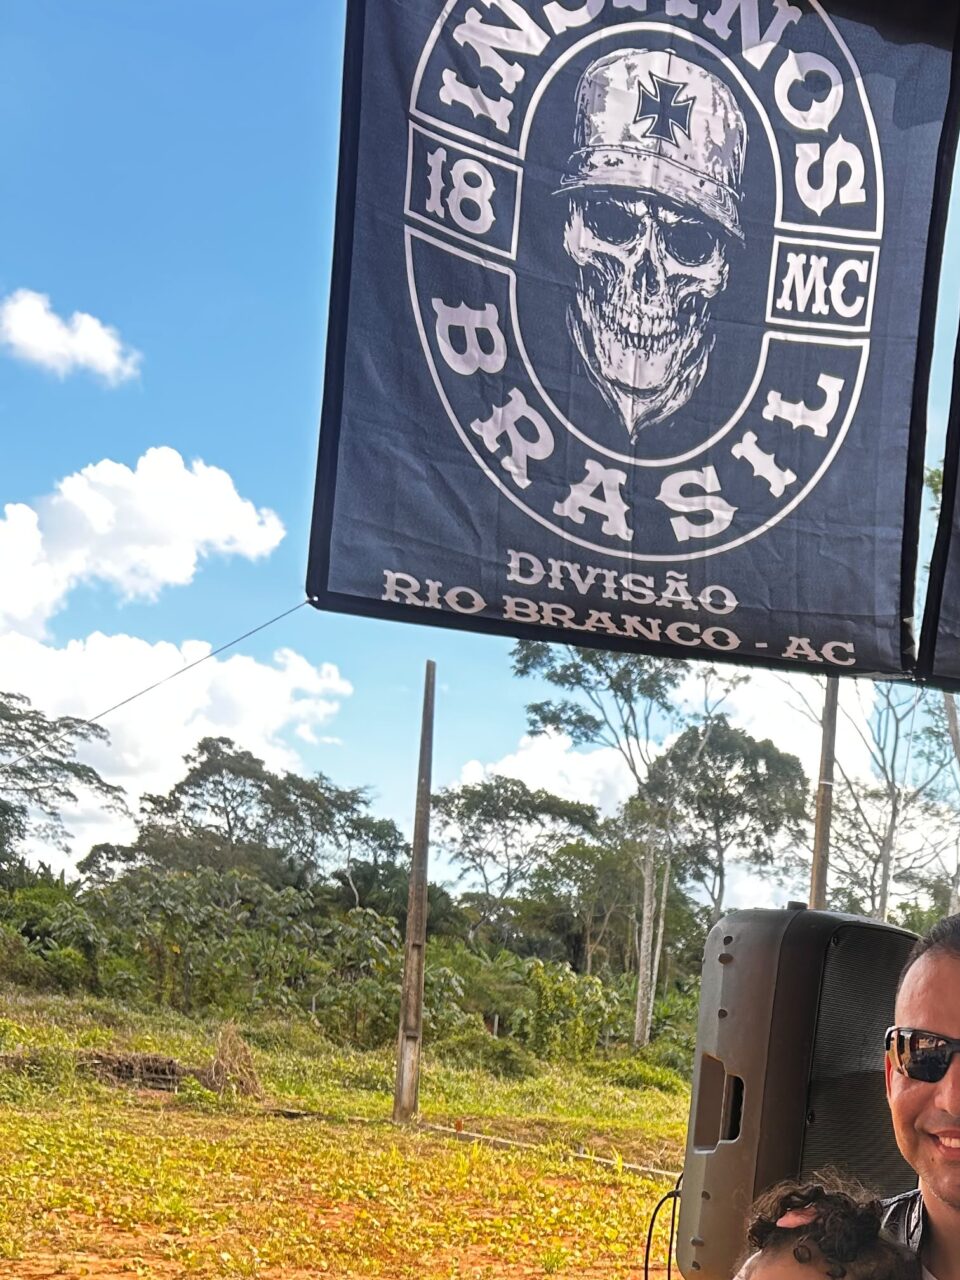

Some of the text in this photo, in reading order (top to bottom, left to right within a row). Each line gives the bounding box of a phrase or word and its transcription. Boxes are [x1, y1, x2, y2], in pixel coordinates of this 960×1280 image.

[425, 146, 496, 235] 18
[774, 251, 868, 318] MC
[432, 296, 847, 542] BRASIL
[382, 569, 488, 615] RIO
[502, 595, 742, 651] BRANCO
[781, 635, 857, 666] AC
[506, 548, 740, 615] DIVISÃO
